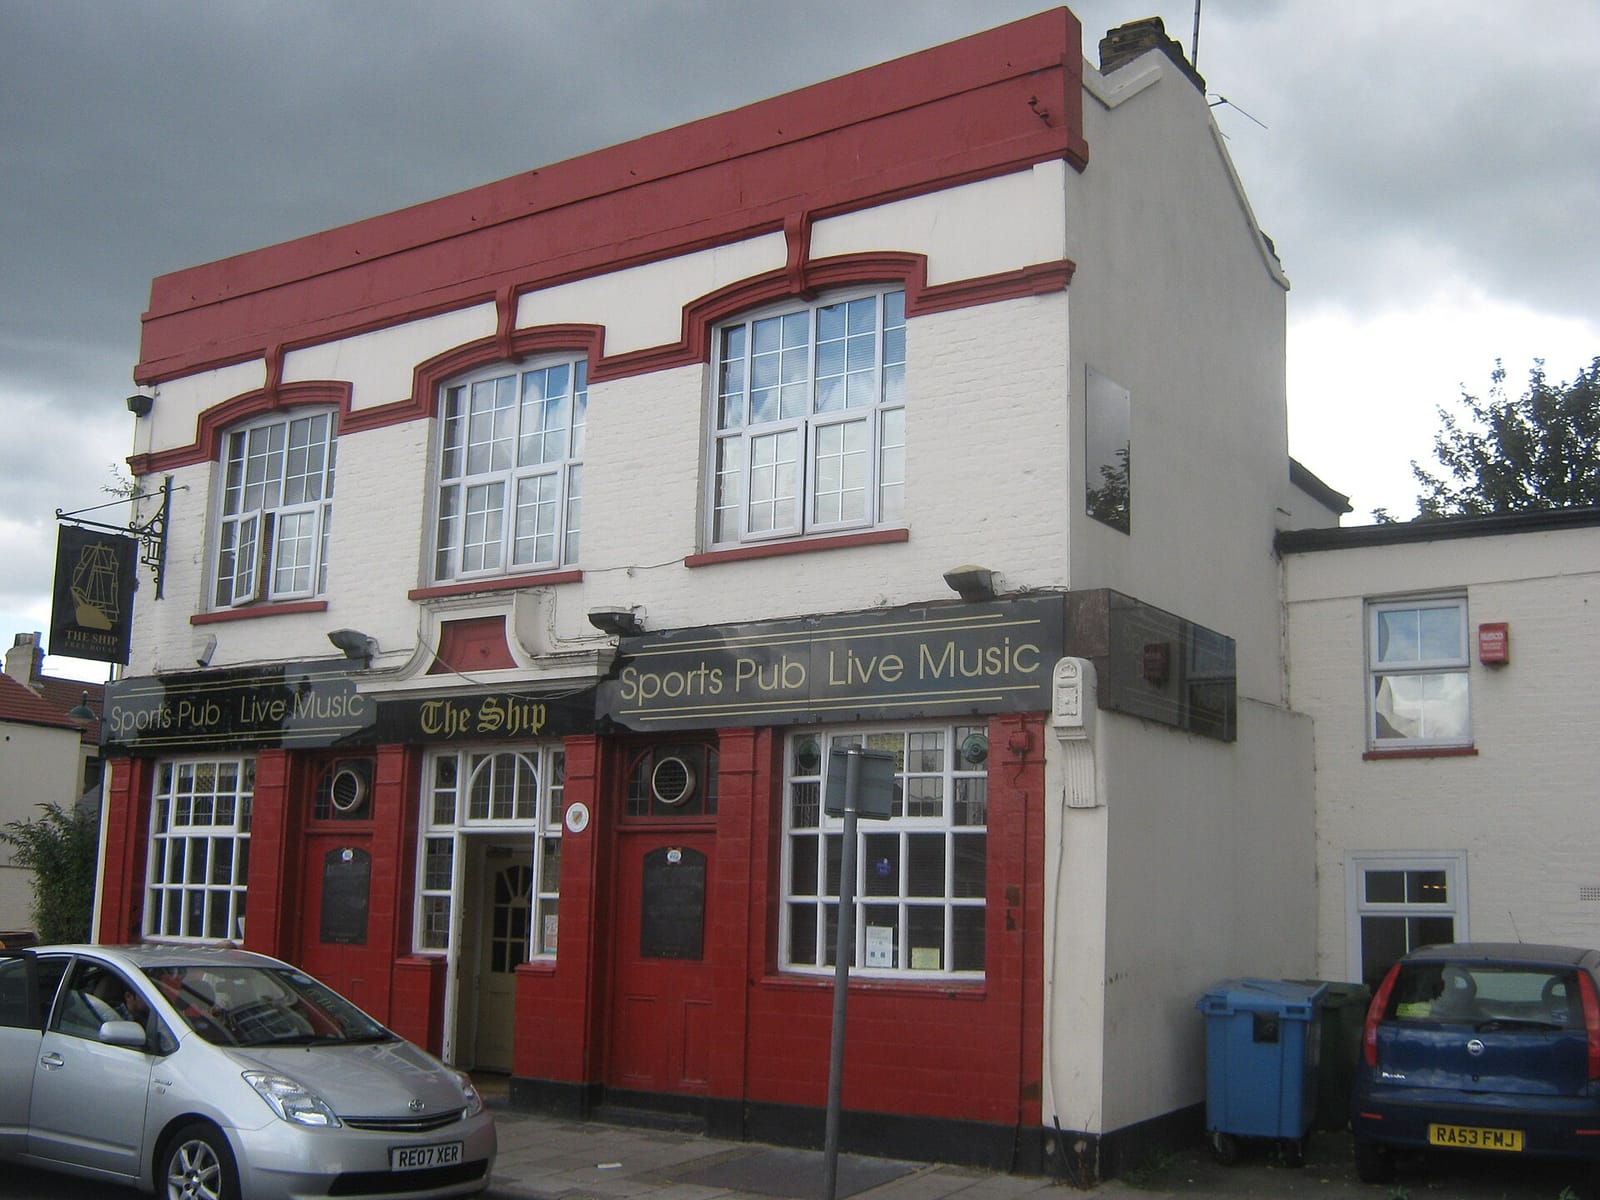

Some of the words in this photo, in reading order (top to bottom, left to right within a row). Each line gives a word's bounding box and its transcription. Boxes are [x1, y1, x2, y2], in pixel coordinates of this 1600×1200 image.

[65, 630, 89, 641] THE
[92, 634, 118, 646] SHIP
[620, 662, 723, 706] Sports
[736, 656, 806, 693] Pub
[829, 650, 903, 686] Live
[920, 637, 1040, 680] Music
[109, 704, 172, 736] Sports
[178, 699, 221, 729] Pub
[240, 694, 285, 723] Live
[292, 689, 365, 719] Music
[420, 700, 471, 735] The
[477, 697, 547, 736] Ship
[1436, 1127, 1478, 1144] RA53
[1482, 1131, 1515, 1147] FMJ
[399, 1148, 434, 1168] RE07
[437, 1145, 459, 1164] XER
